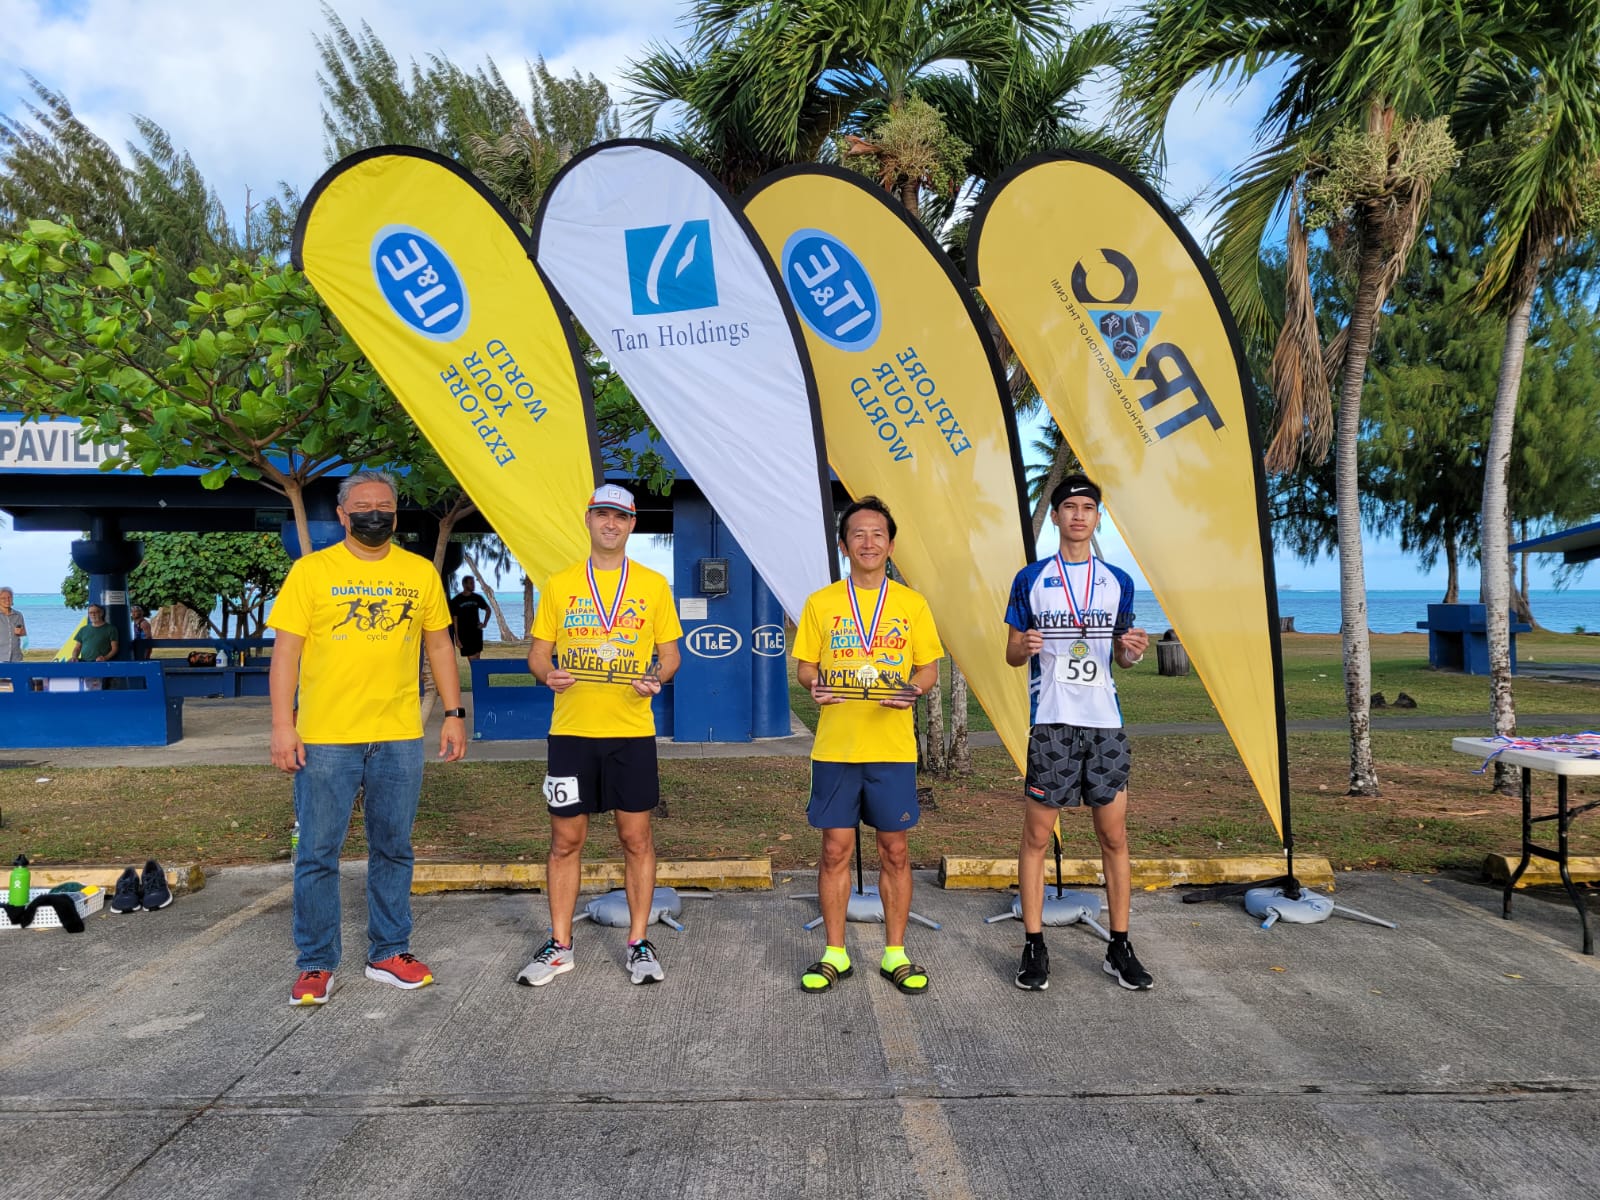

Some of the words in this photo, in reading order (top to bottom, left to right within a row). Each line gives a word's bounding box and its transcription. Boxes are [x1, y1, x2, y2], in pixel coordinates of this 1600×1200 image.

[381, 238, 459, 328] IT&E
[611, 328, 649, 352] Tan
[657, 320, 750, 347] Holdings
[463, 351, 513, 418] YOUR
[486, 338, 548, 423] WORLD
[440, 364, 516, 467] EXPLORE
[0, 428, 127, 462] PAVILIO
[347, 579, 405, 587] SAIPAN
[331, 586, 393, 596] DUATHLON
[395, 587, 419, 599] 2022
[565, 607, 594, 615] SAIPAN
[1032, 612, 1076, 628] NEVER
[1081, 612, 1113, 628] GIVE
[565, 614, 643, 629] AQUALON
[366, 633, 388, 642] cycle
[695, 632, 731, 650] IT&E
[755, 632, 784, 649] IT&E
[831, 635, 905, 649] AQUHLON
[567, 647, 600, 657] PATHW
[561, 654, 603, 671] NEVER
[609, 658, 640, 674] GIVE
[1067, 659, 1097, 682] 59
[547, 782, 568, 803] 56
